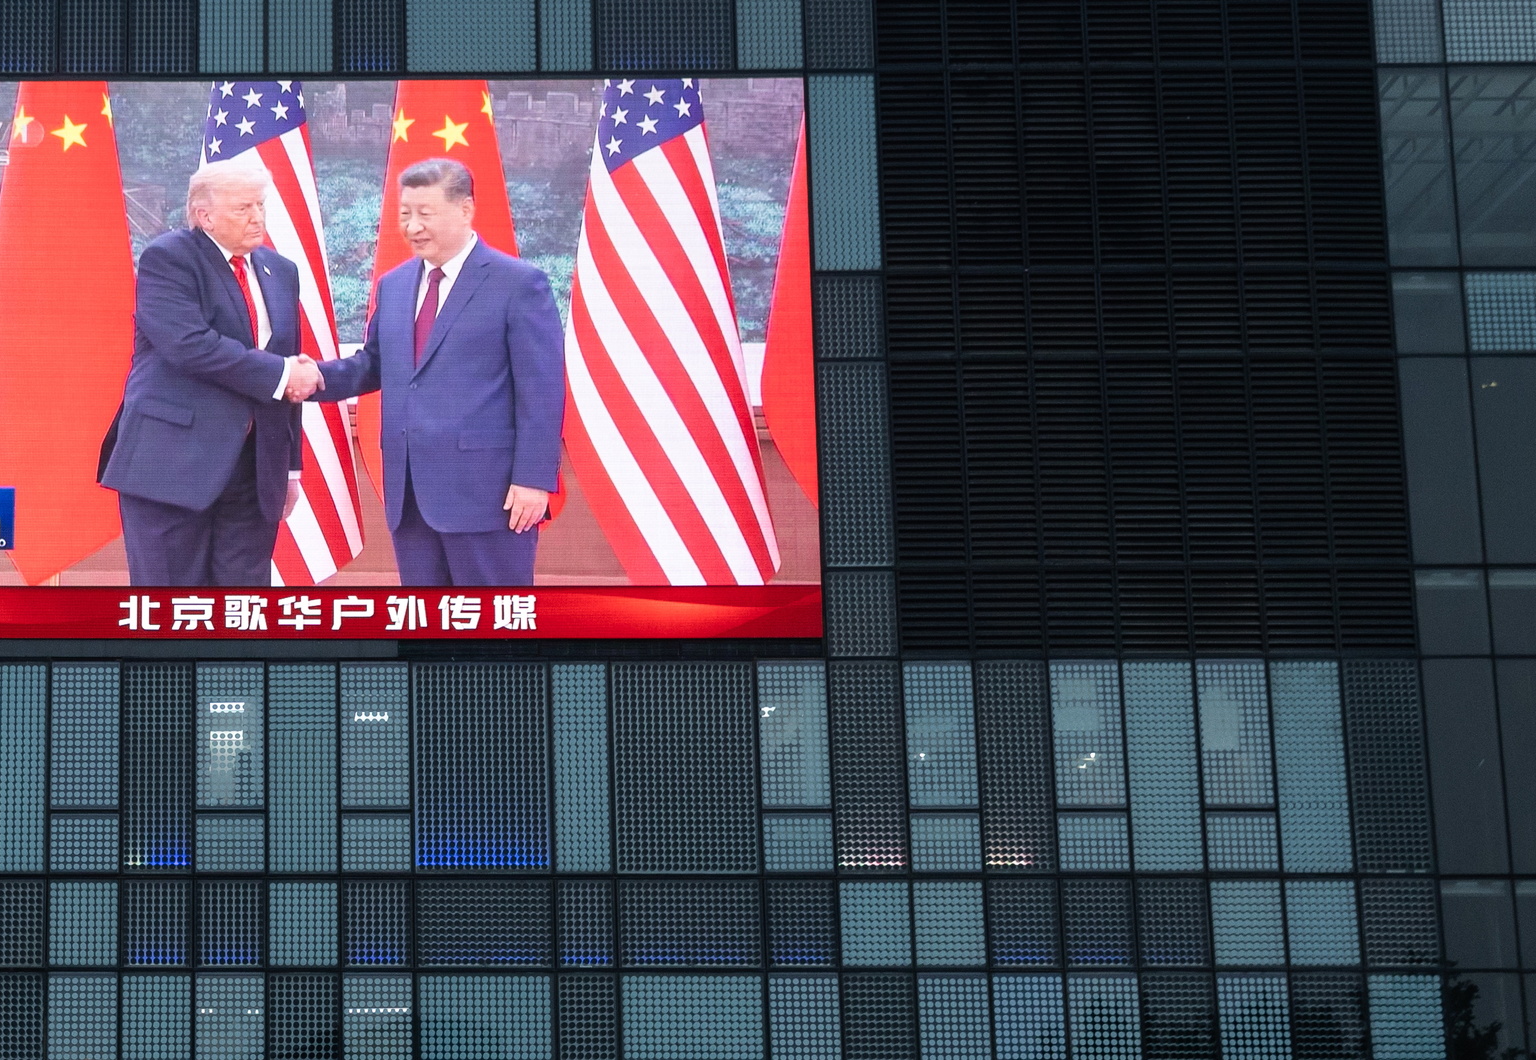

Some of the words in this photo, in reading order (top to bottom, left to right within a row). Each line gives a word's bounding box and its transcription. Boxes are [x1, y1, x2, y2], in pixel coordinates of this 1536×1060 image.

[118, 594, 538, 631] 北京歌华户外传媒
